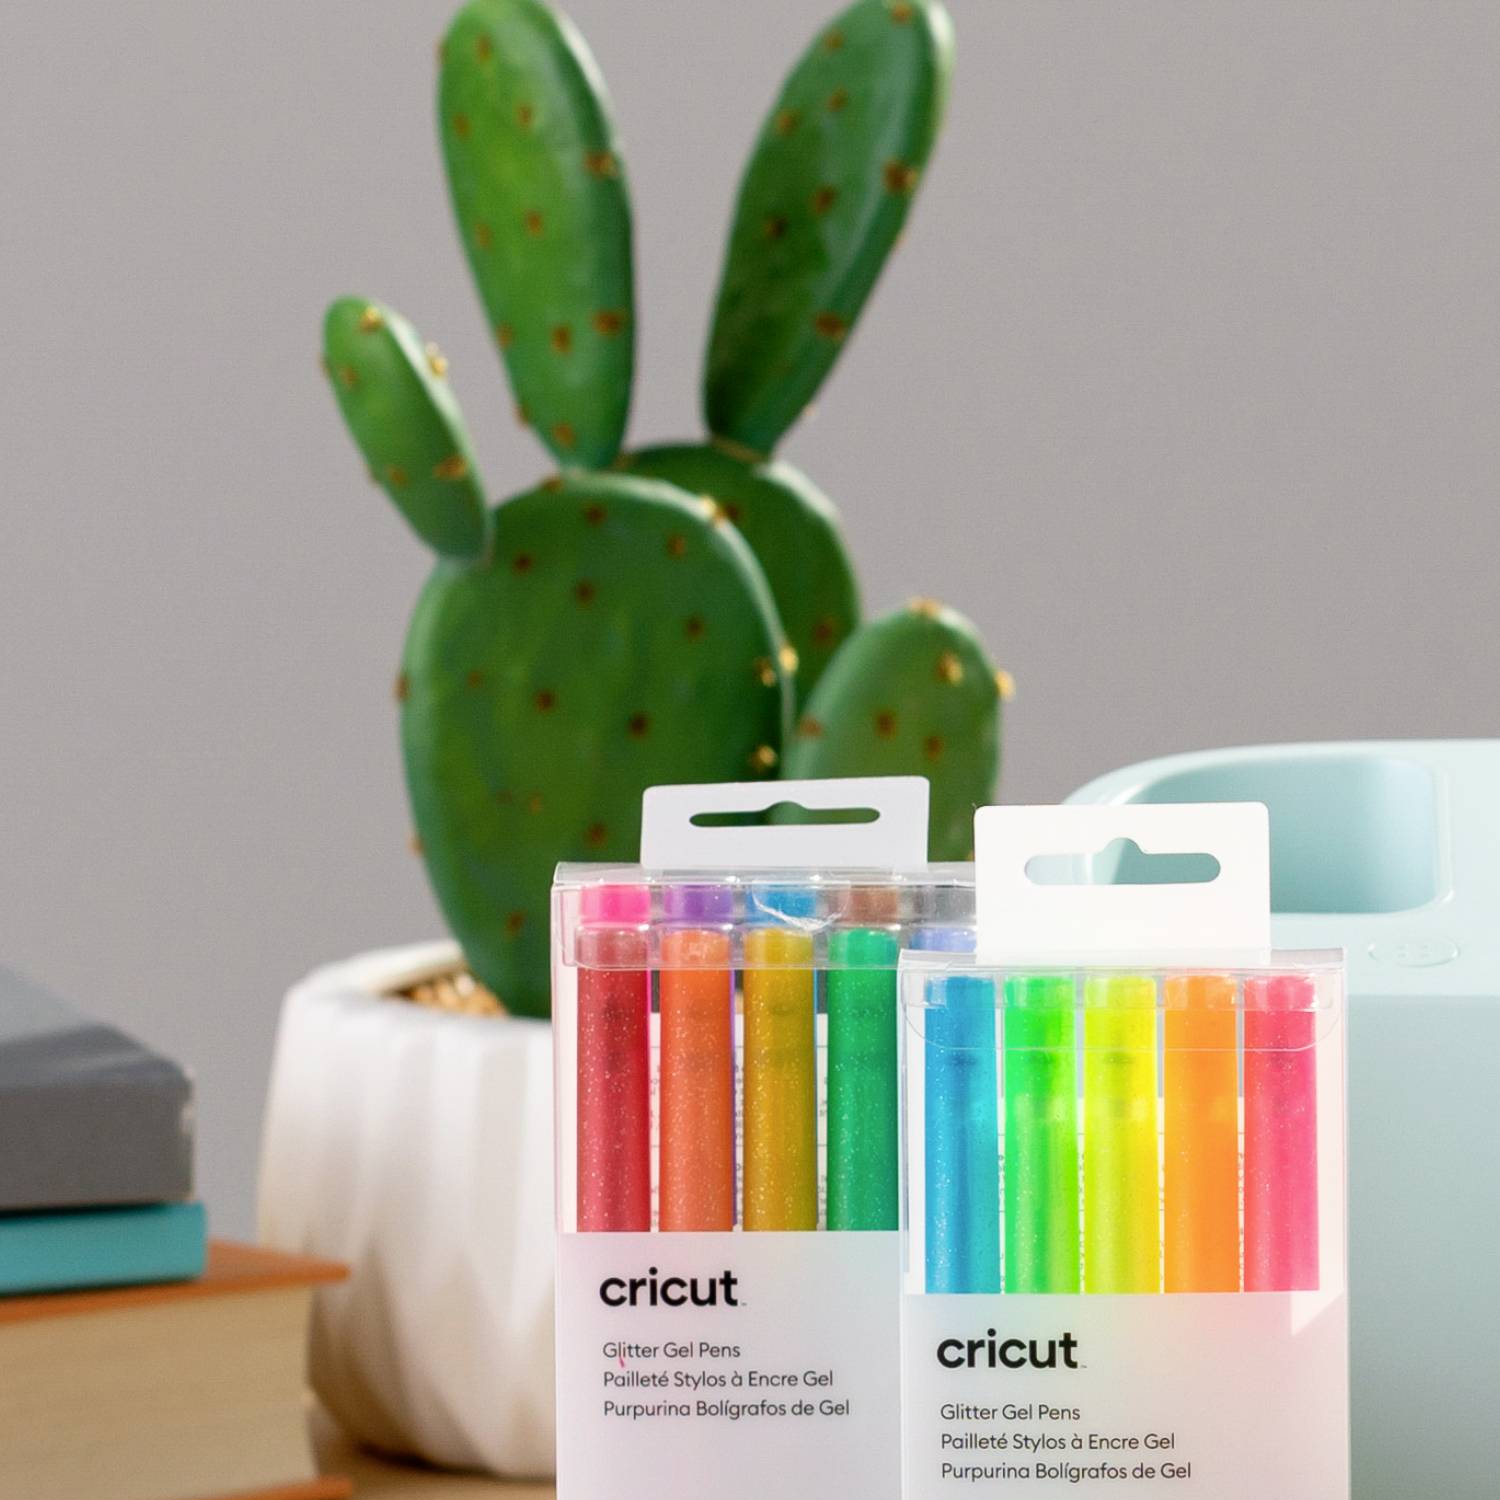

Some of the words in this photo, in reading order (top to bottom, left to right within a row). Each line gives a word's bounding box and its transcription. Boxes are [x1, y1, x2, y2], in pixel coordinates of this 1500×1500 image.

[598, 1265, 739, 1307] cricut
[602, 1341, 660, 1359] Glitter
[662, 1341, 694, 1359] Gel
[699, 1341, 742, 1359] Pens
[936, 1327, 1079, 1369] cricut
[603, 1370, 670, 1388] Pailleté
[673, 1370, 727, 1392] Stylos
[730, 1369, 744, 1388] à
[748, 1370, 799, 1388] Encre
[802, 1369, 834, 1388] Gel
[603, 1399, 691, 1421] Purpurina
[695, 1398, 787, 1421] Bolígrafos
[790, 1398, 814, 1417] de
[818, 1398, 850, 1417] Gel
[940, 1403, 999, 1421] Glitter
[1001, 1403, 1033, 1421] Gel
[1038, 1403, 1081, 1421] Pens
[941, 1431, 1009, 1450] Pailleté
[1012, 1432, 1067, 1454] Stylos
[1070, 1431, 1083, 1450] à
[1088, 1433, 1140, 1450] Encre
[1143, 1431, 1175, 1450] Gel
[941, 1461, 1031, 1483] Purpurina
[1035, 1461, 1128, 1484] Bolígrafos
[1131, 1461, 1156, 1480] de
[1159, 1461, 1192, 1480] Gel
